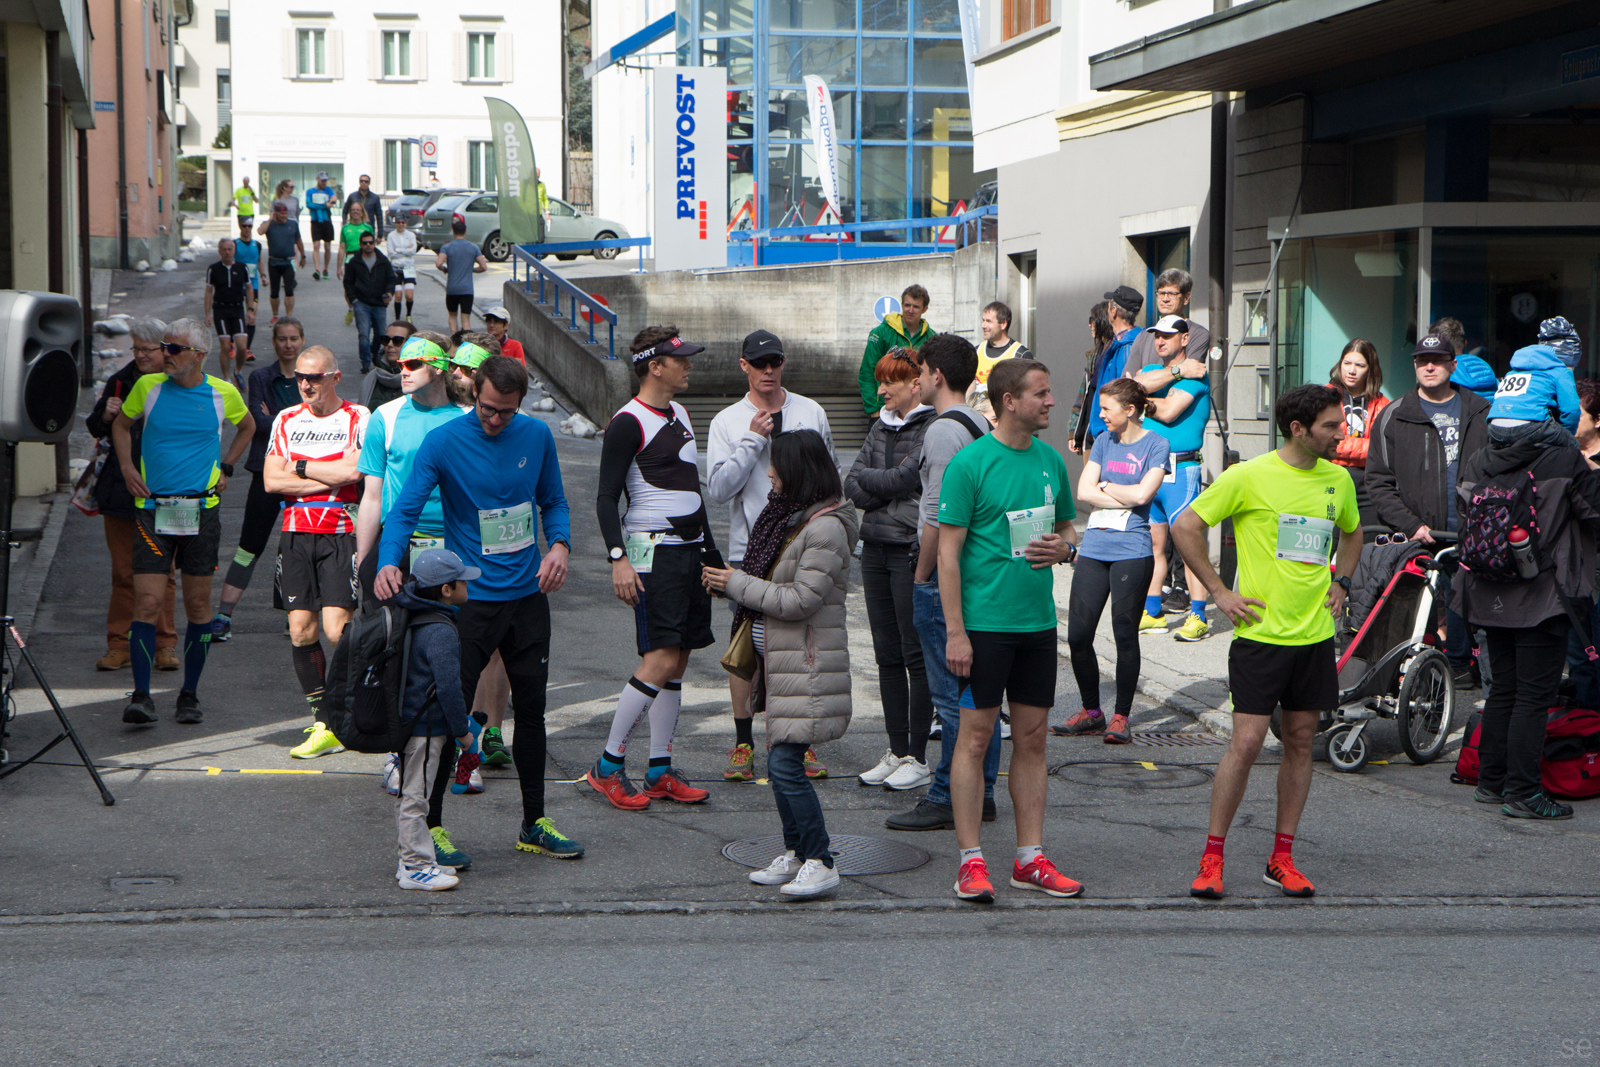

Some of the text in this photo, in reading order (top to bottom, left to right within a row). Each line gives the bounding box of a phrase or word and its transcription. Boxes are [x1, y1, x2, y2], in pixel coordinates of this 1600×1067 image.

[675, 73, 696, 220] PREVOST
[819, 104, 839, 205] dormakaba
[1497, 376, 1527, 394] 289
[290, 430, 348, 444] tg hütten
[1105, 460, 1137, 476] PUMA
[175, 510, 187, 518] 169
[166, 518, 196, 527] ANDREAS
[1031, 521, 1045, 532] 122
[497, 521, 525, 542] 234
[1294, 531, 1321, 551] 290
[626, 547, 639, 562] 13
